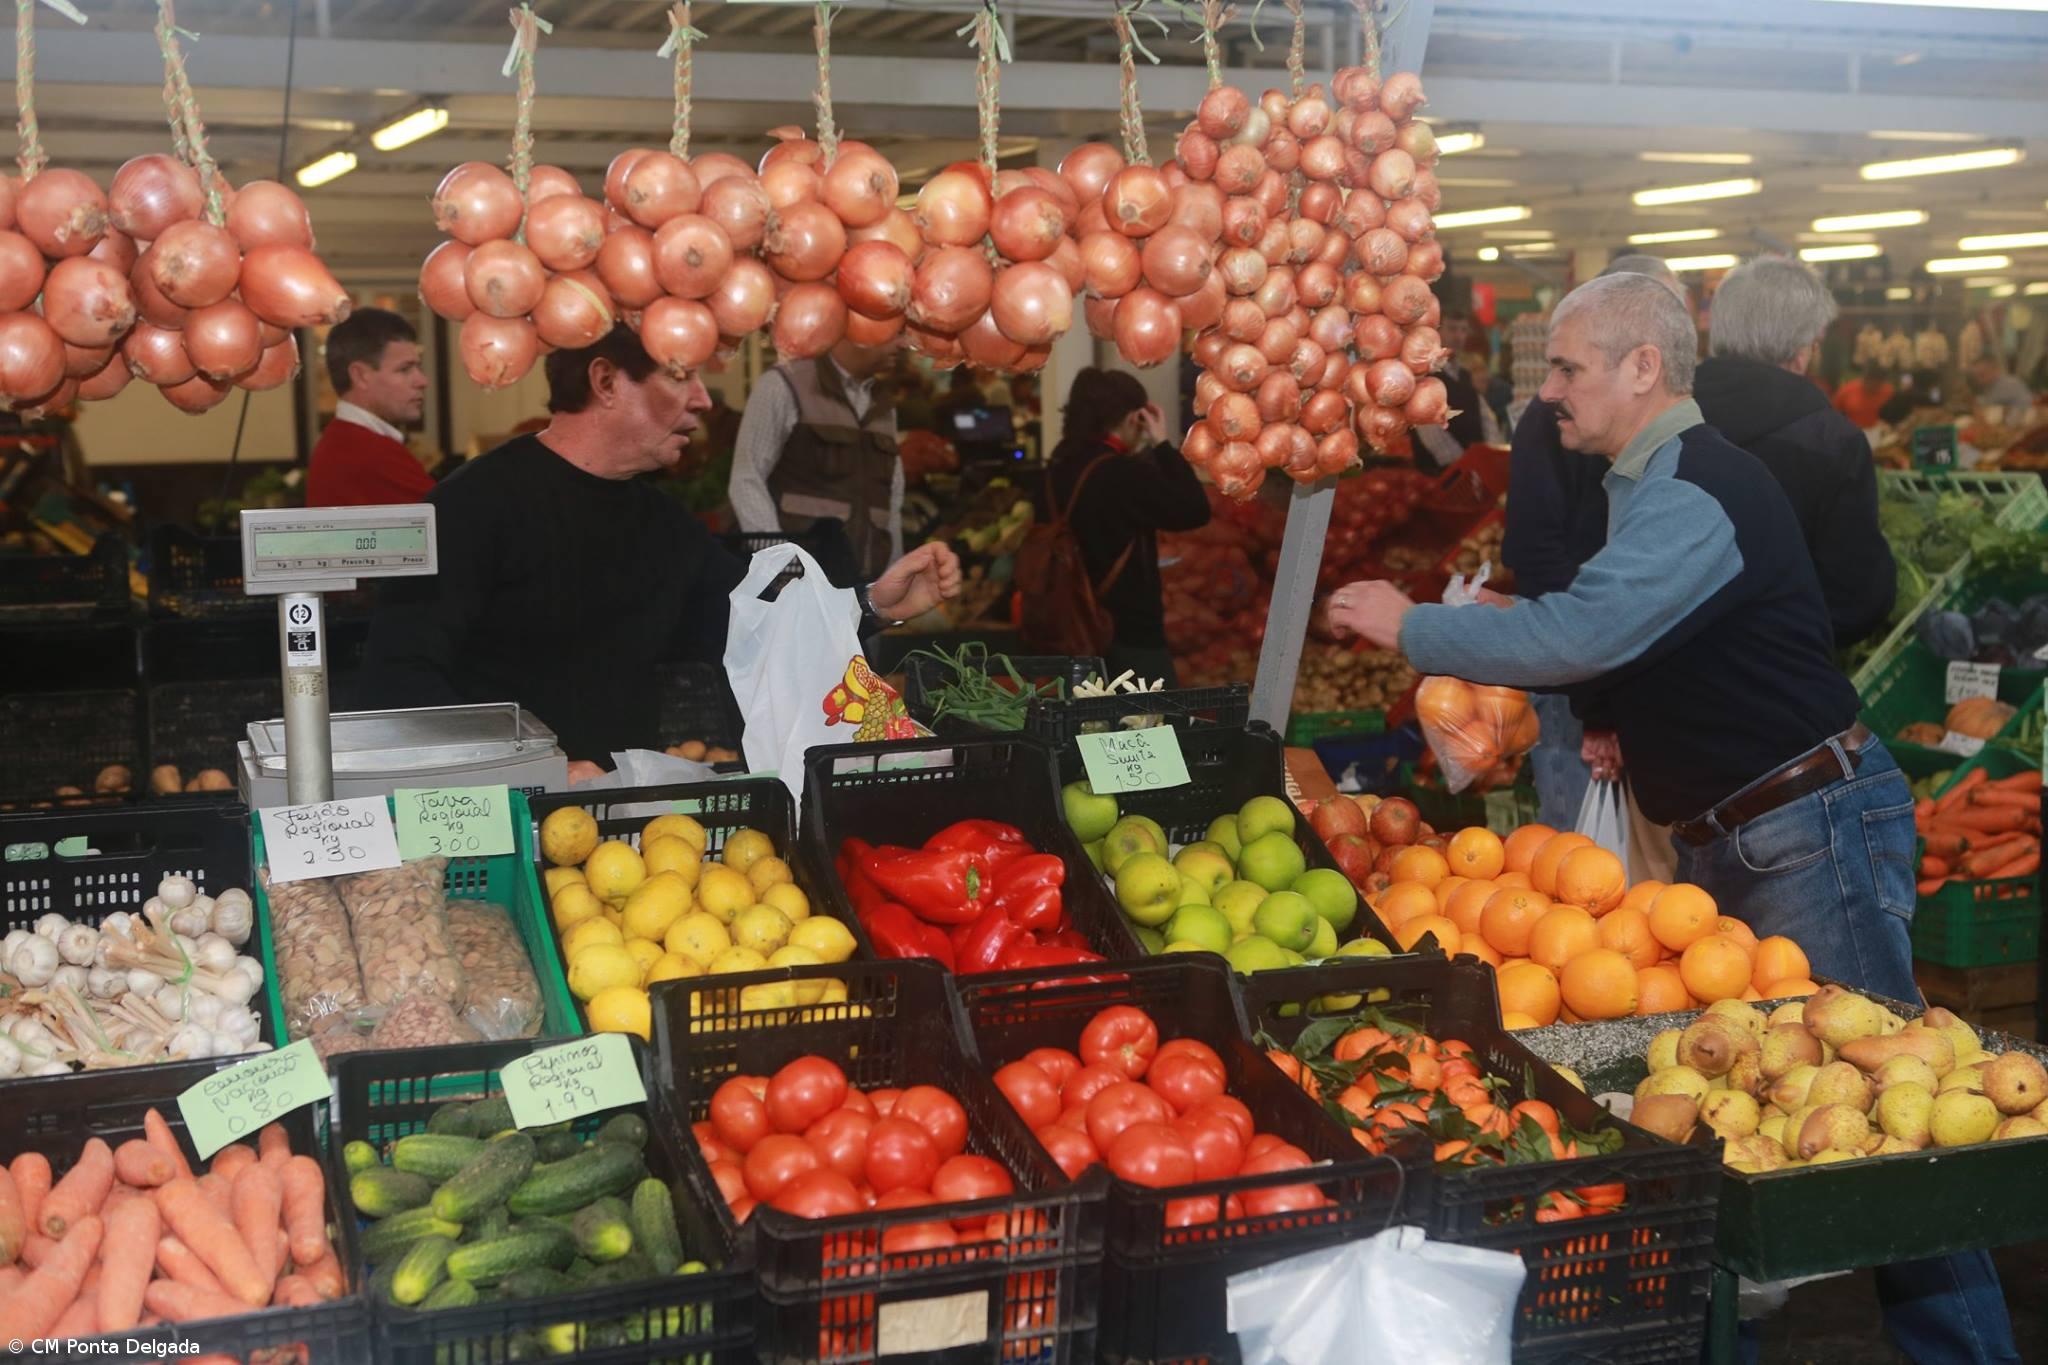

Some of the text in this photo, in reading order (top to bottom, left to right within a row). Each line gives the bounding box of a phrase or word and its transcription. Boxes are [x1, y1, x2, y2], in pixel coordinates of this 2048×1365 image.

[294, 608, 307, 619] 12
[419, 797, 491, 826] Regional
[285, 810, 376, 840] Regional
[429, 835, 480, 854] 3.00
